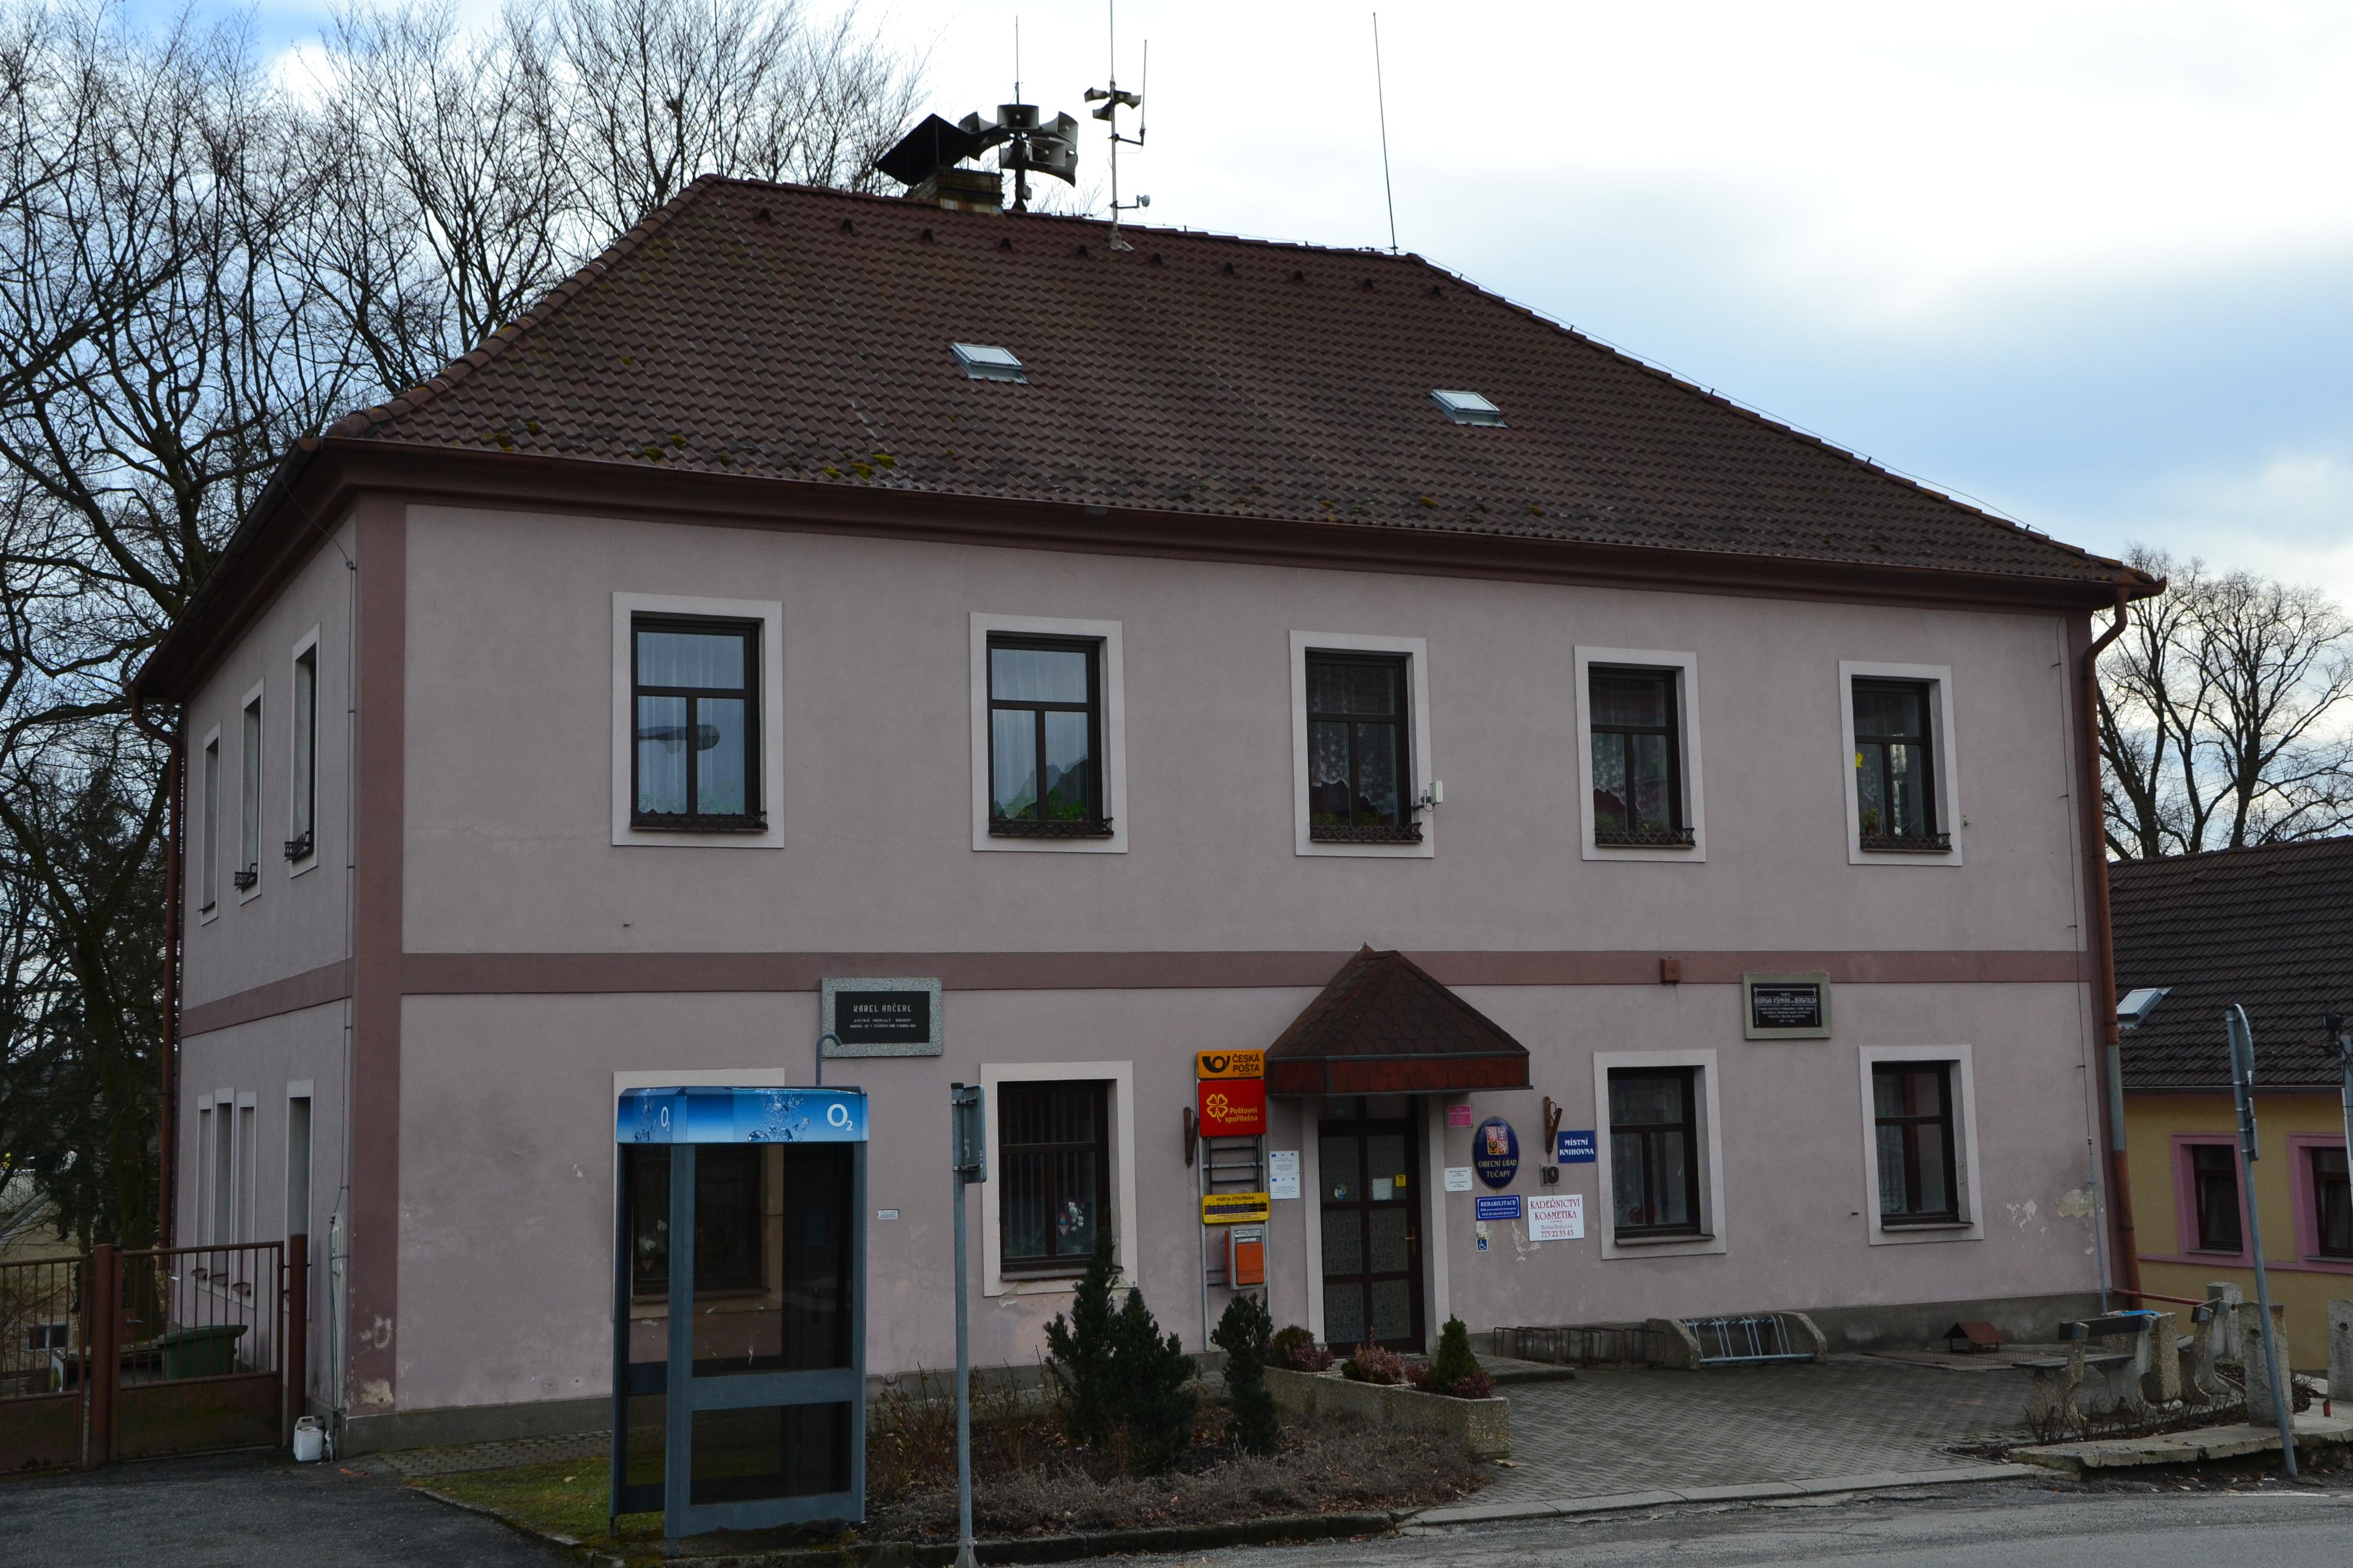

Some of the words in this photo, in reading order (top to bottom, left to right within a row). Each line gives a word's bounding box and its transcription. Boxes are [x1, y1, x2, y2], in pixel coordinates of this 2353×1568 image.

[882, 1003, 912, 1012] ANČERL
[1232, 1053, 1260, 1063] ČESKÁ
[1233, 1063, 1260, 1072] POŠTA
[1230, 1106, 1257, 1115] Poštovní
[1225, 1115, 1258, 1124] spořitelna
[1565, 1137, 1588, 1146] MÍSTNÍ
[1478, 1159, 1501, 1167] OBECNÍ
[1502, 1158, 1517, 1167] ÚŘAD
[1486, 1170, 1511, 1178] TUČAPY
[1542, 1166, 1559, 1184] 19
[1530, 1197, 1580, 1209] KADEŘNICTVÍ
[1534, 1210, 1577, 1220] KOSMETIKA
